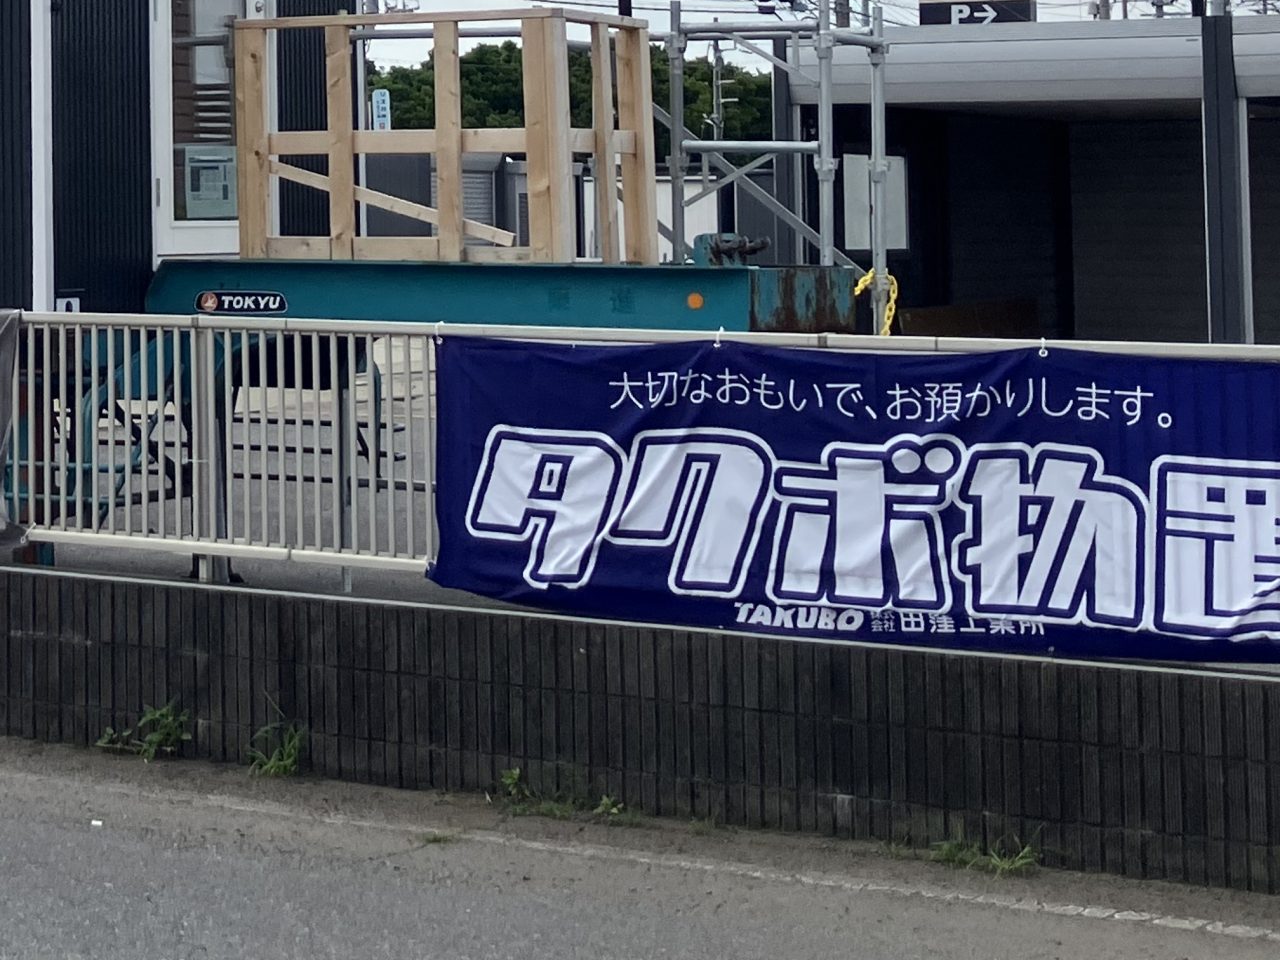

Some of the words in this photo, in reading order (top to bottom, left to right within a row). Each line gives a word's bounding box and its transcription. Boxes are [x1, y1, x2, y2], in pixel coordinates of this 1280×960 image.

[950, 4, 971, 25] P
[221, 296, 280, 309] TOKYU
[608, 368, 1173, 429] 大切なおもいで、お預かりします。
[734, 602, 864, 631] TAKUBO
